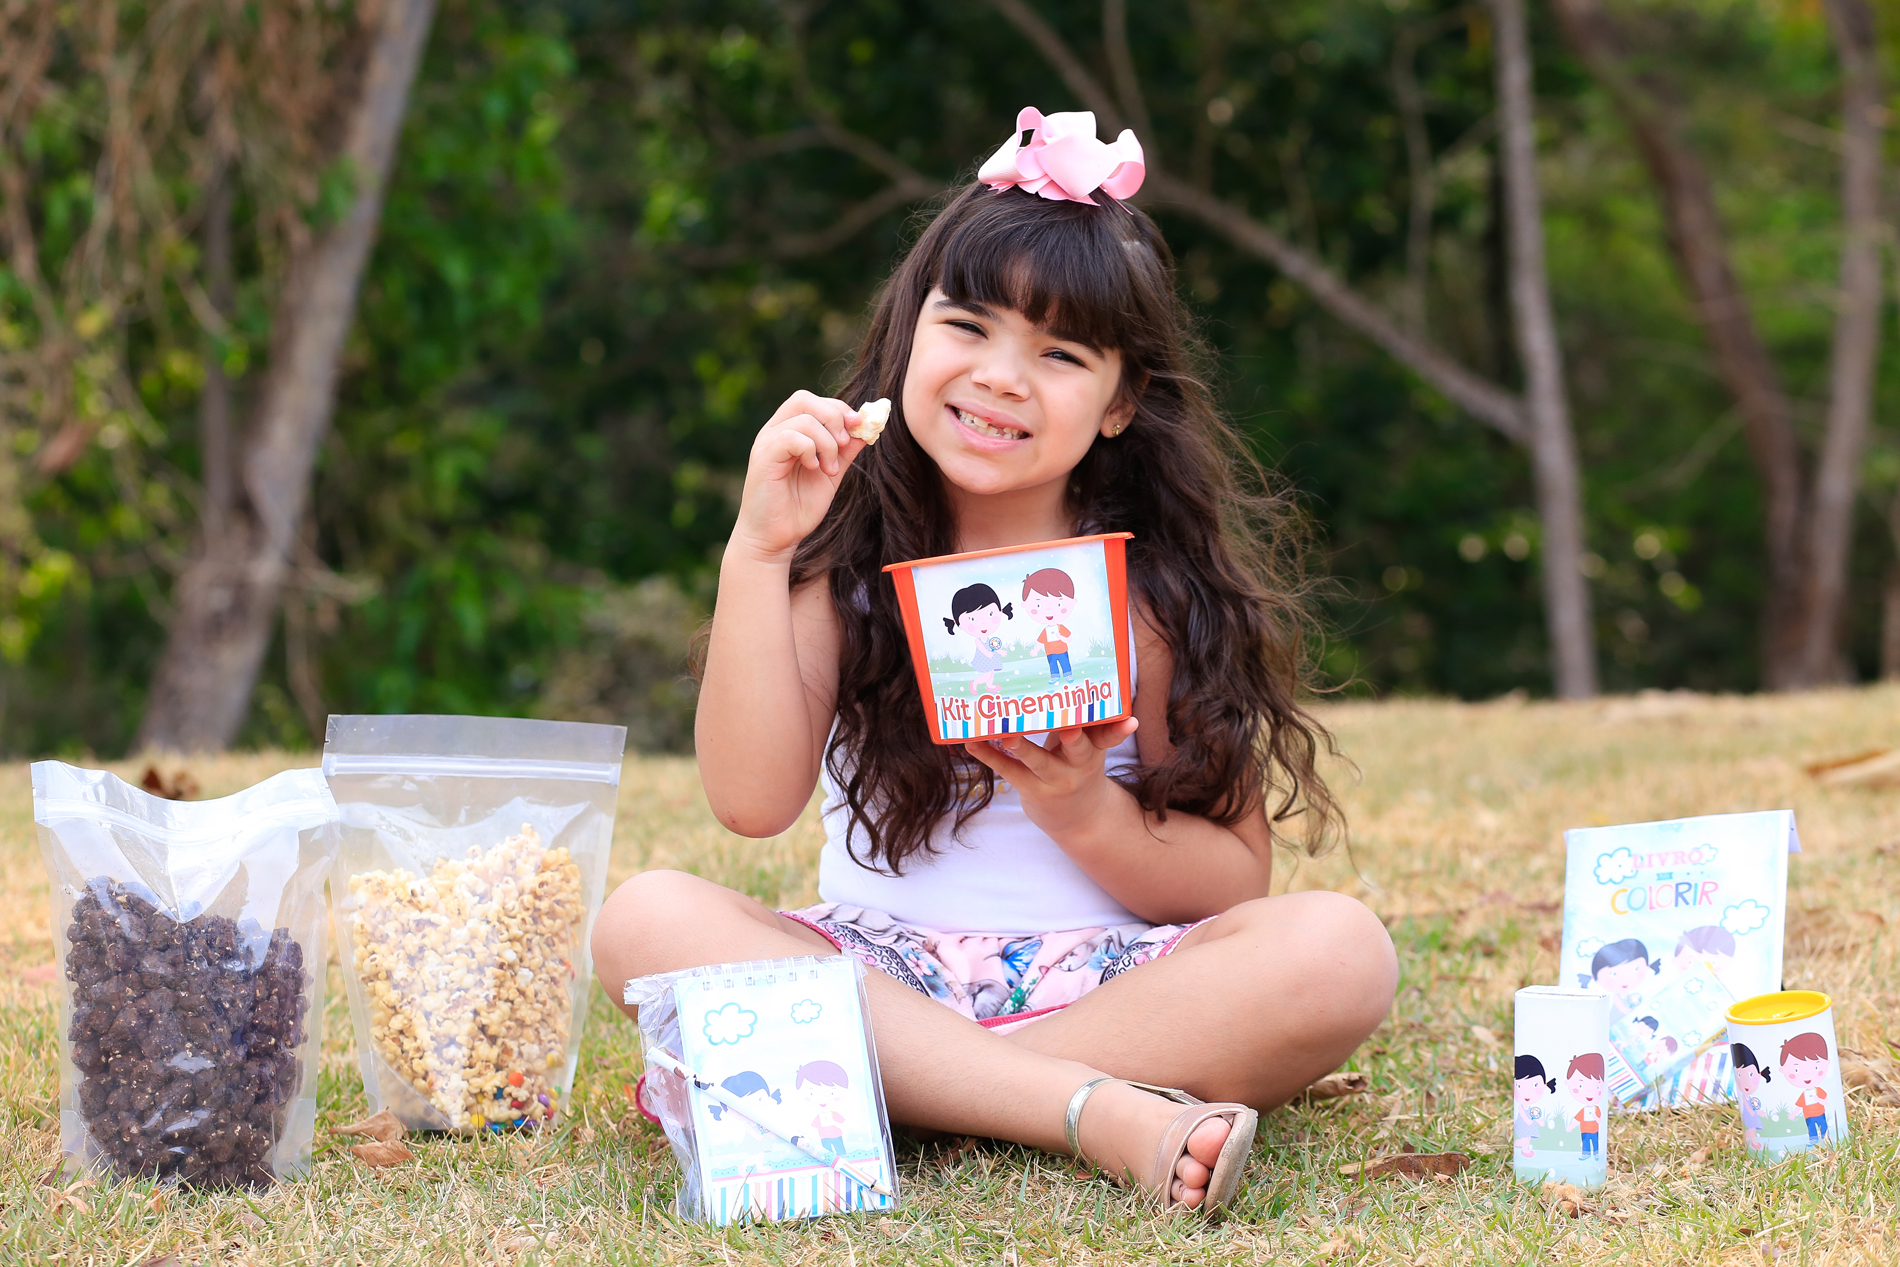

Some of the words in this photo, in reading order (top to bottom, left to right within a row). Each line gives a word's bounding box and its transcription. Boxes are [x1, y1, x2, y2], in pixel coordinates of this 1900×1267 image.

[942, 697, 971, 720] Kit
[978, 679, 1112, 719] Cineminha
[1632, 849, 1703, 869] LIVRO
[1610, 881, 1719, 915] COLORIR
